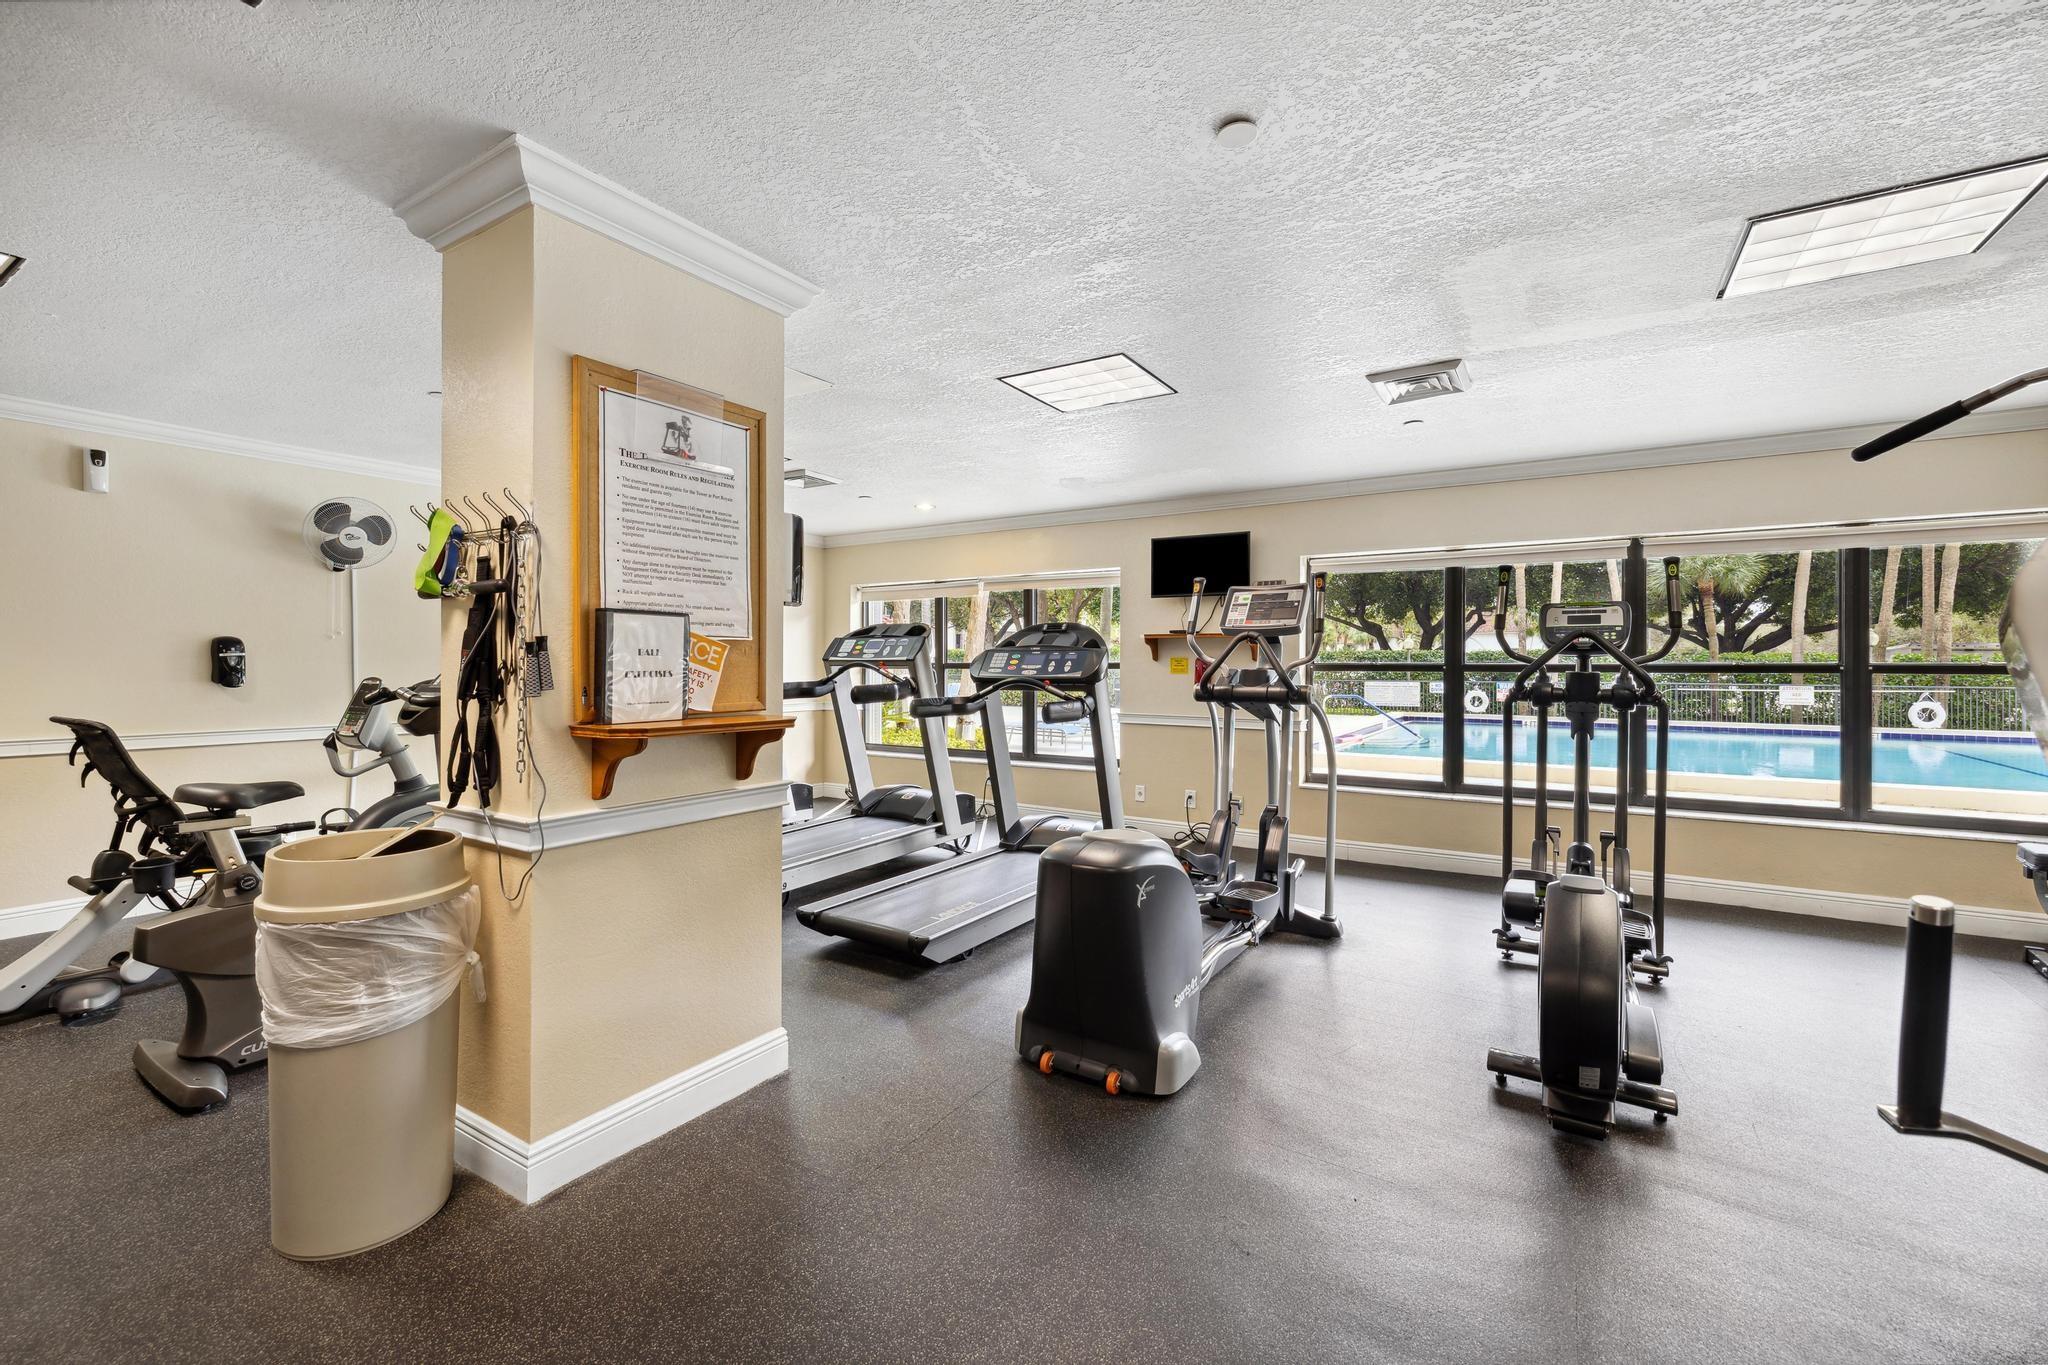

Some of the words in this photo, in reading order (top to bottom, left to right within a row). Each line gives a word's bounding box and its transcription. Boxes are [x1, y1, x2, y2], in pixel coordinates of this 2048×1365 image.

[620, 459, 649, 472] EXERCISE
[650, 466, 668, 476] ROOM
[669, 470, 687, 480] RULES
[688, 474, 699, 482] AND
[700, 476, 734, 490] REGULATIONS
[696, 680, 704, 688] IS
